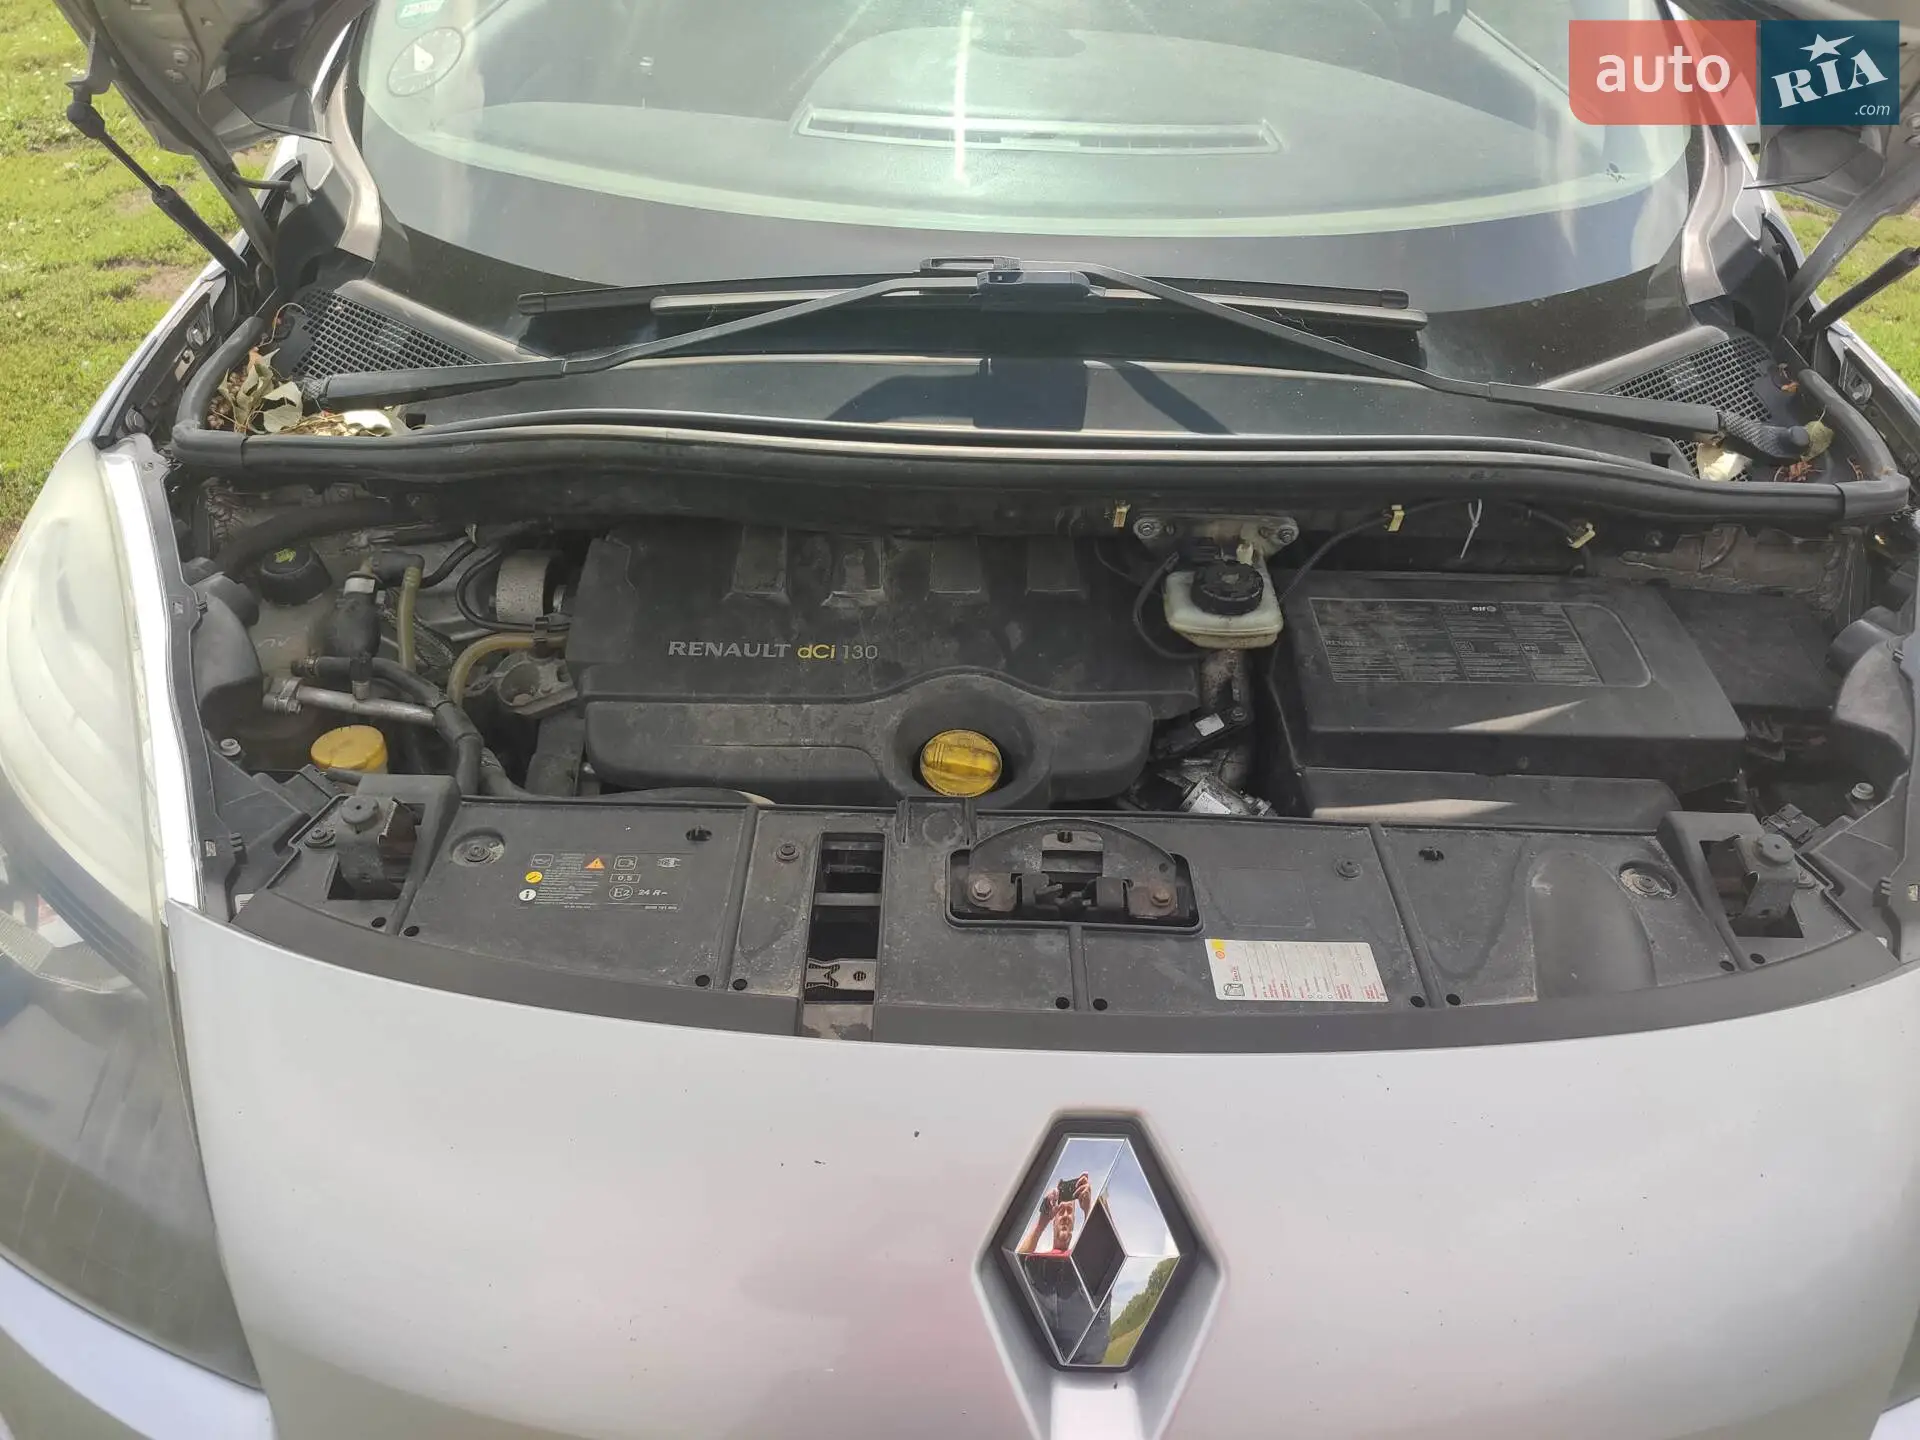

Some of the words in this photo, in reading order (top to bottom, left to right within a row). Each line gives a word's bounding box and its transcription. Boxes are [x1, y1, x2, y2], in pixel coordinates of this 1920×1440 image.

[668, 640, 791, 658] RENAULT
[797, 644, 836, 659] dCi
[842, 645, 878, 660] 130
